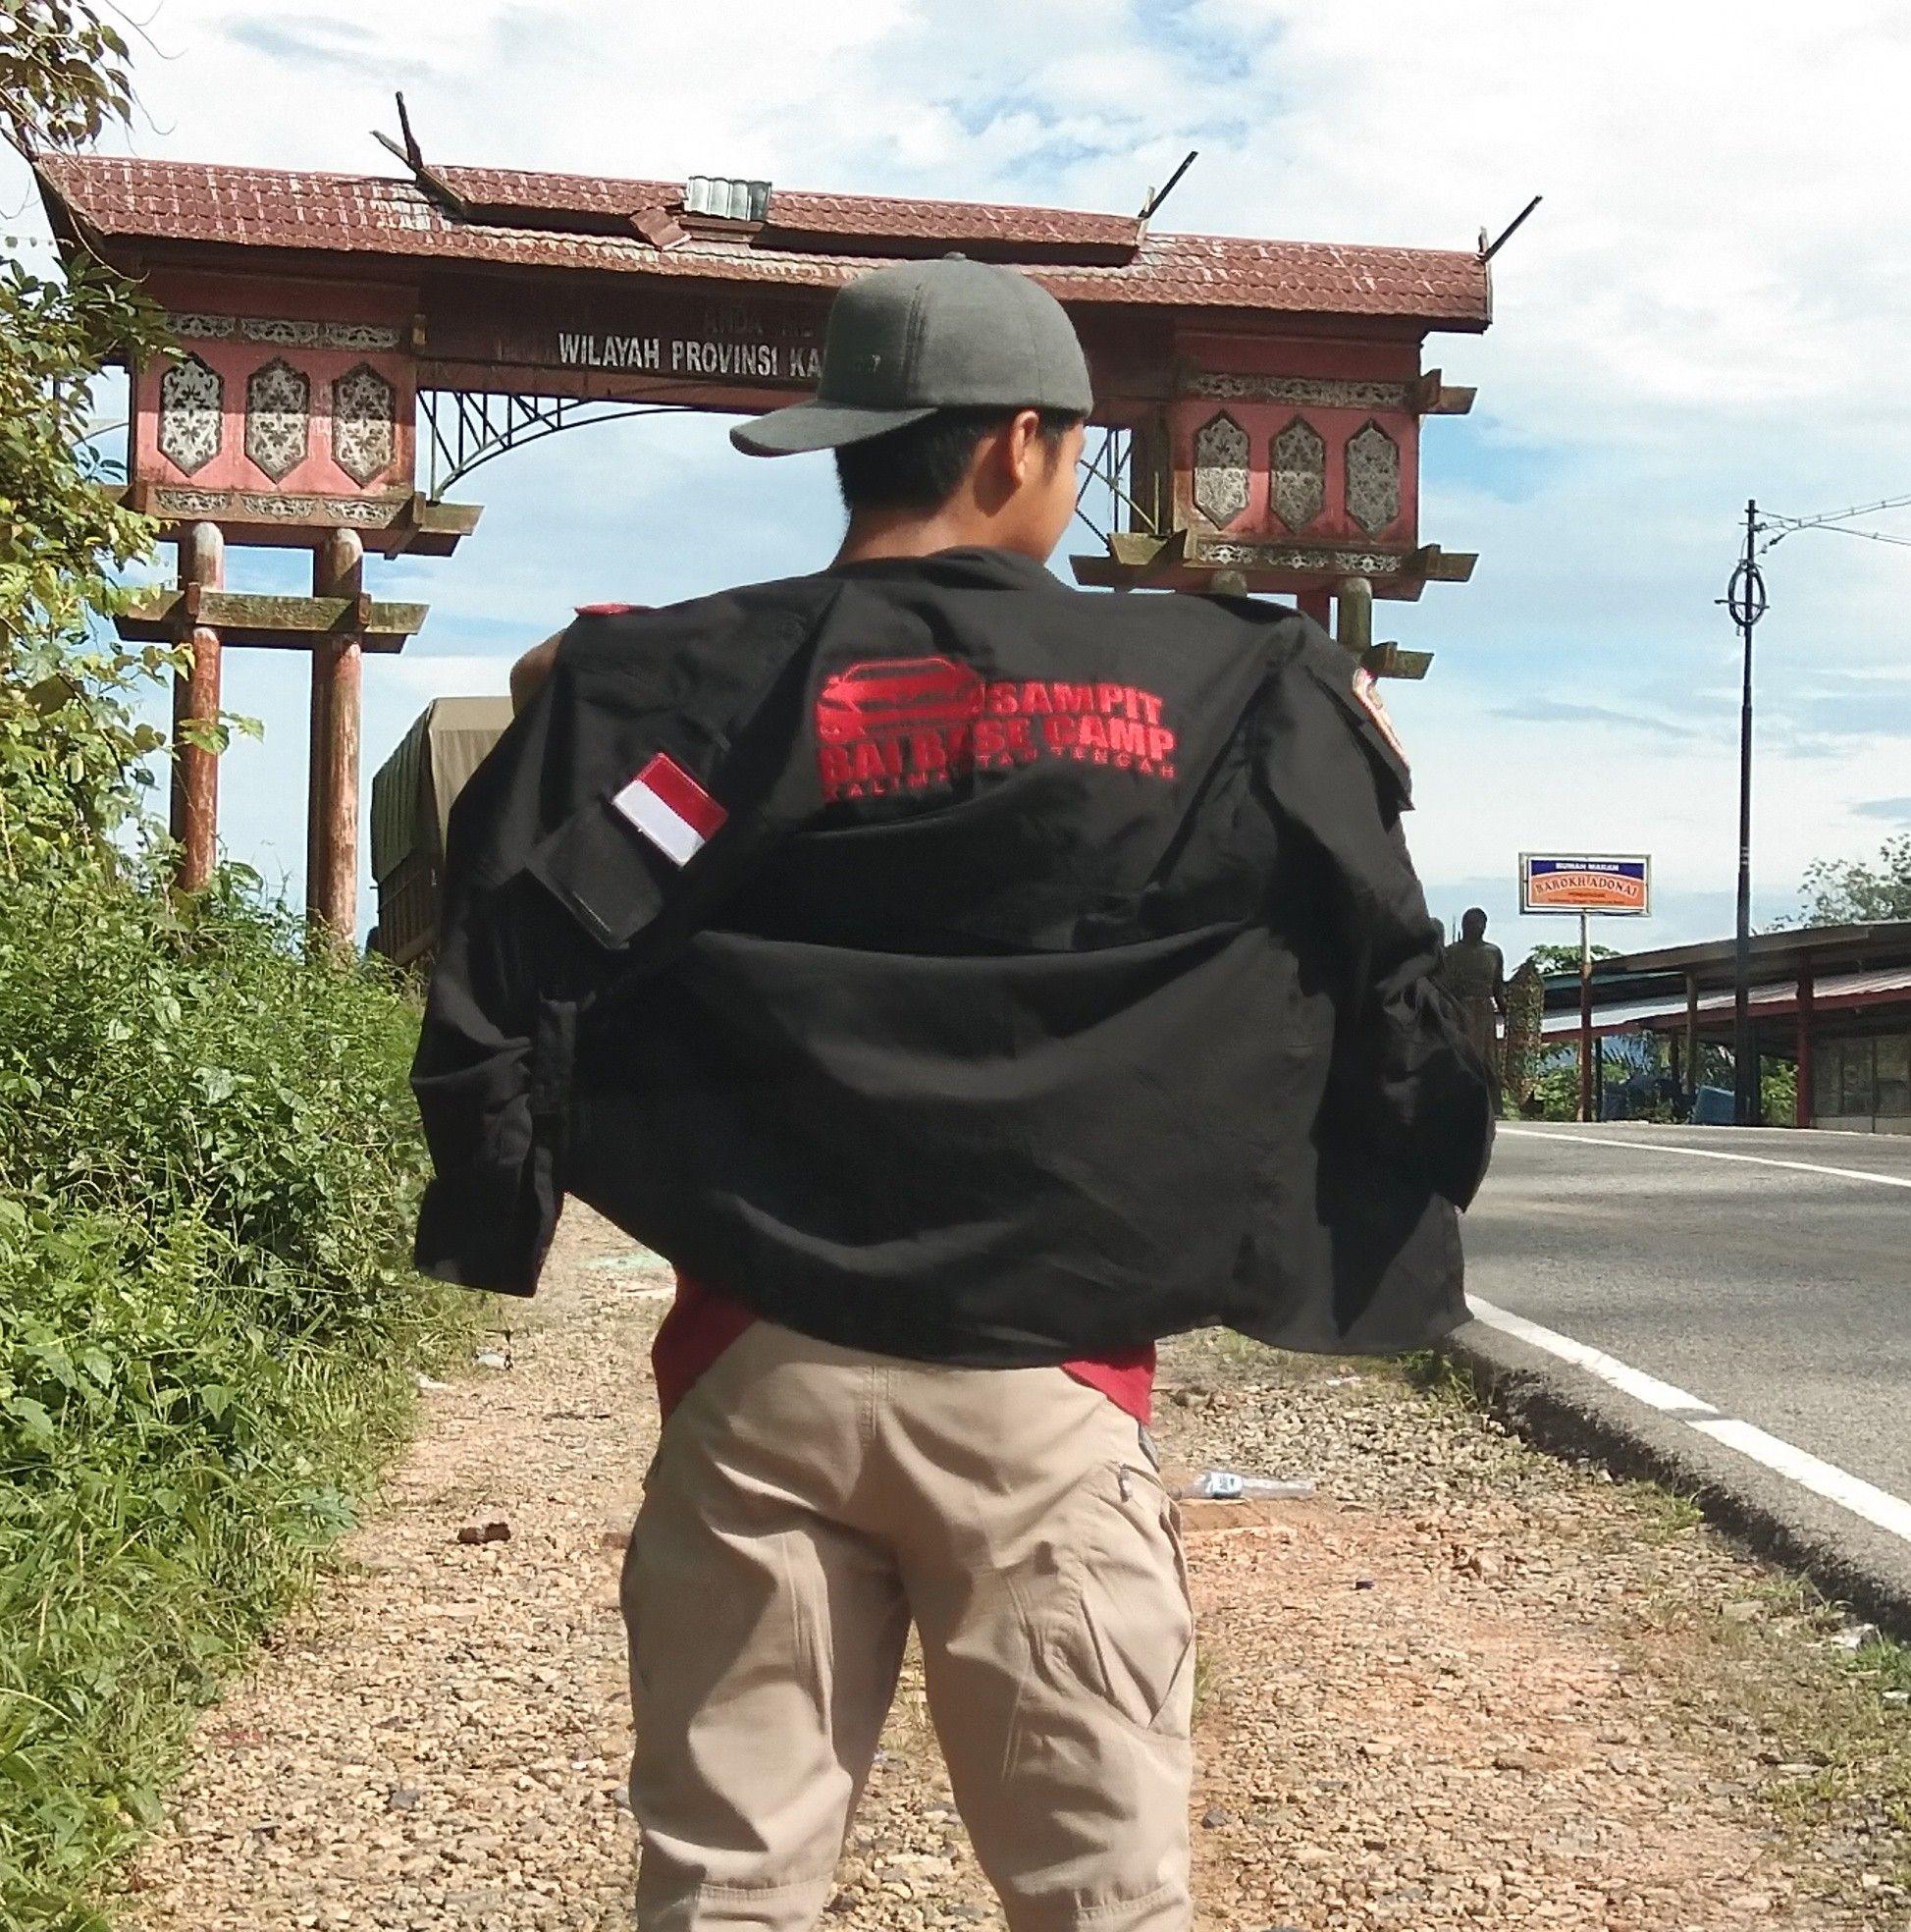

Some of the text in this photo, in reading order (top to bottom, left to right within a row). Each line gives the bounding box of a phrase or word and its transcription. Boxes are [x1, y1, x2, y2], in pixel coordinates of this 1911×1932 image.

[557, 332, 826, 379] WILAYAH PROVINSI KA
[988, 680, 1163, 725] SAMPIT
[1042, 714, 1175, 761] CAMP
